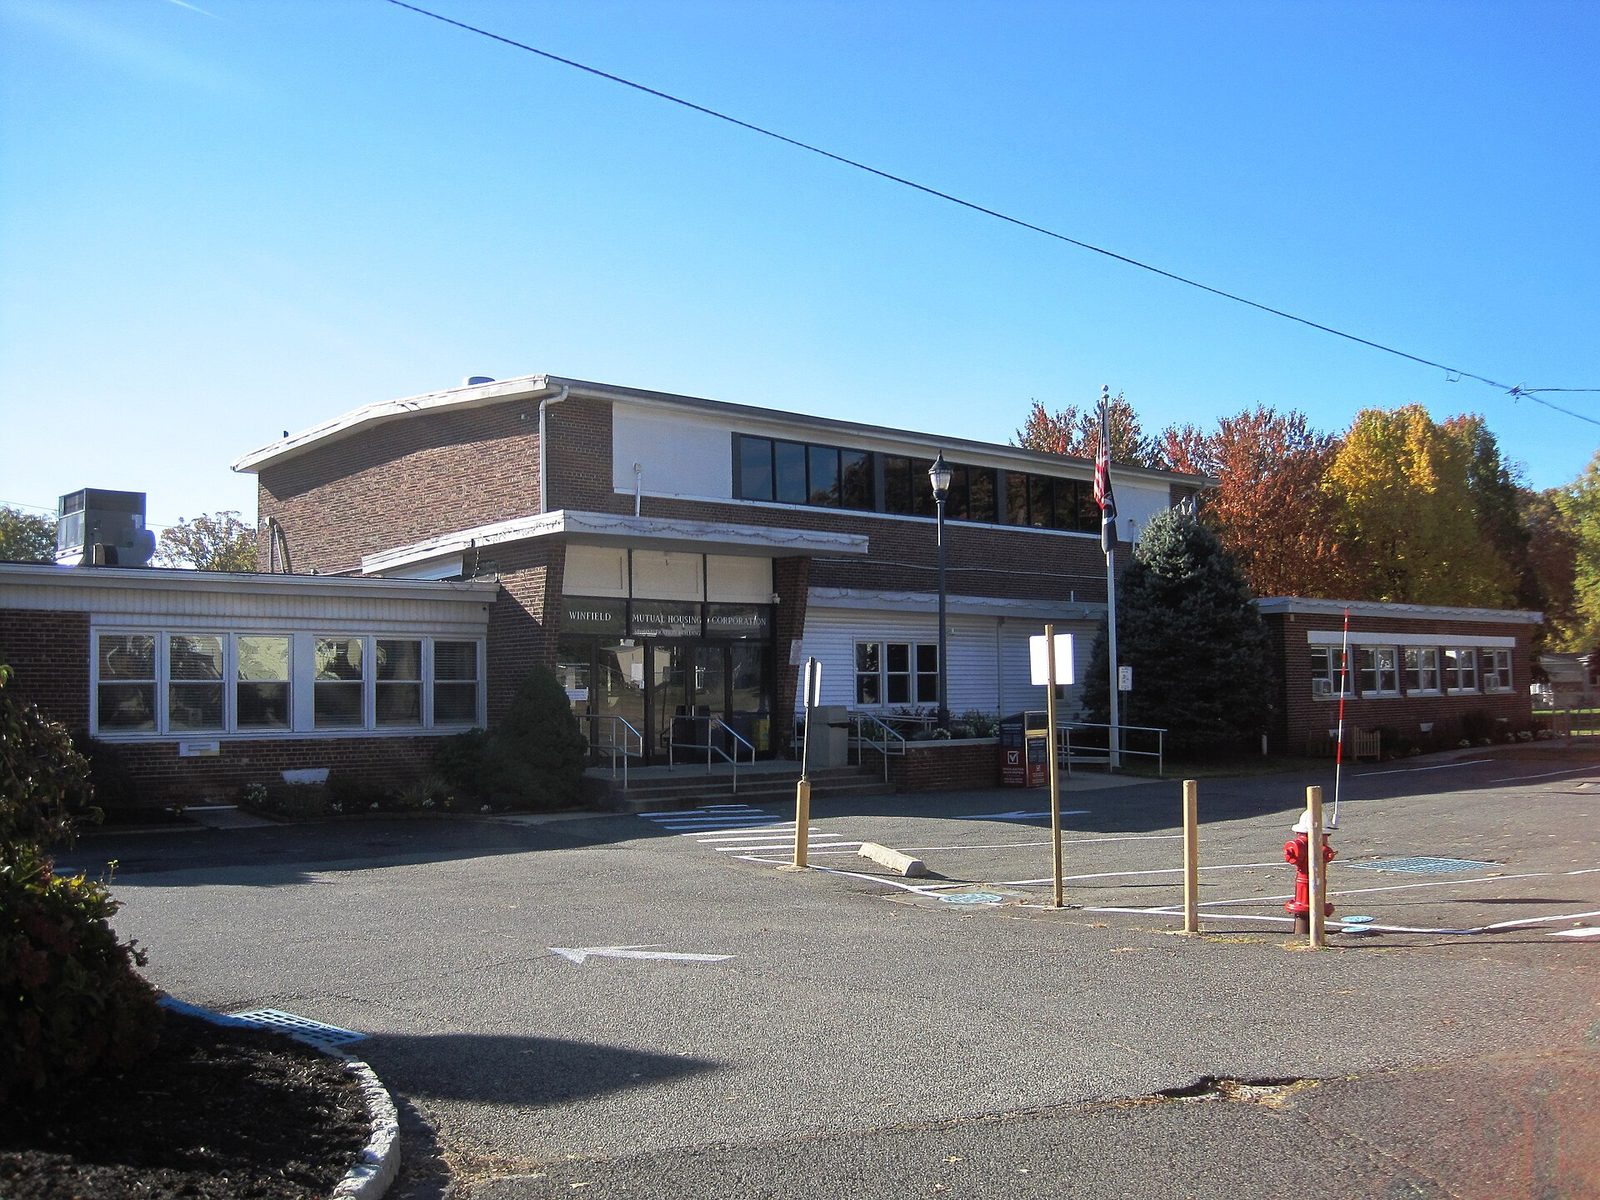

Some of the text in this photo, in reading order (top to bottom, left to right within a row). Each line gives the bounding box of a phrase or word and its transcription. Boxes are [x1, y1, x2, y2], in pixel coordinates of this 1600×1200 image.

[569, 611, 766, 626] WINFIELD MUTUAL HOUSING CORPORATION
